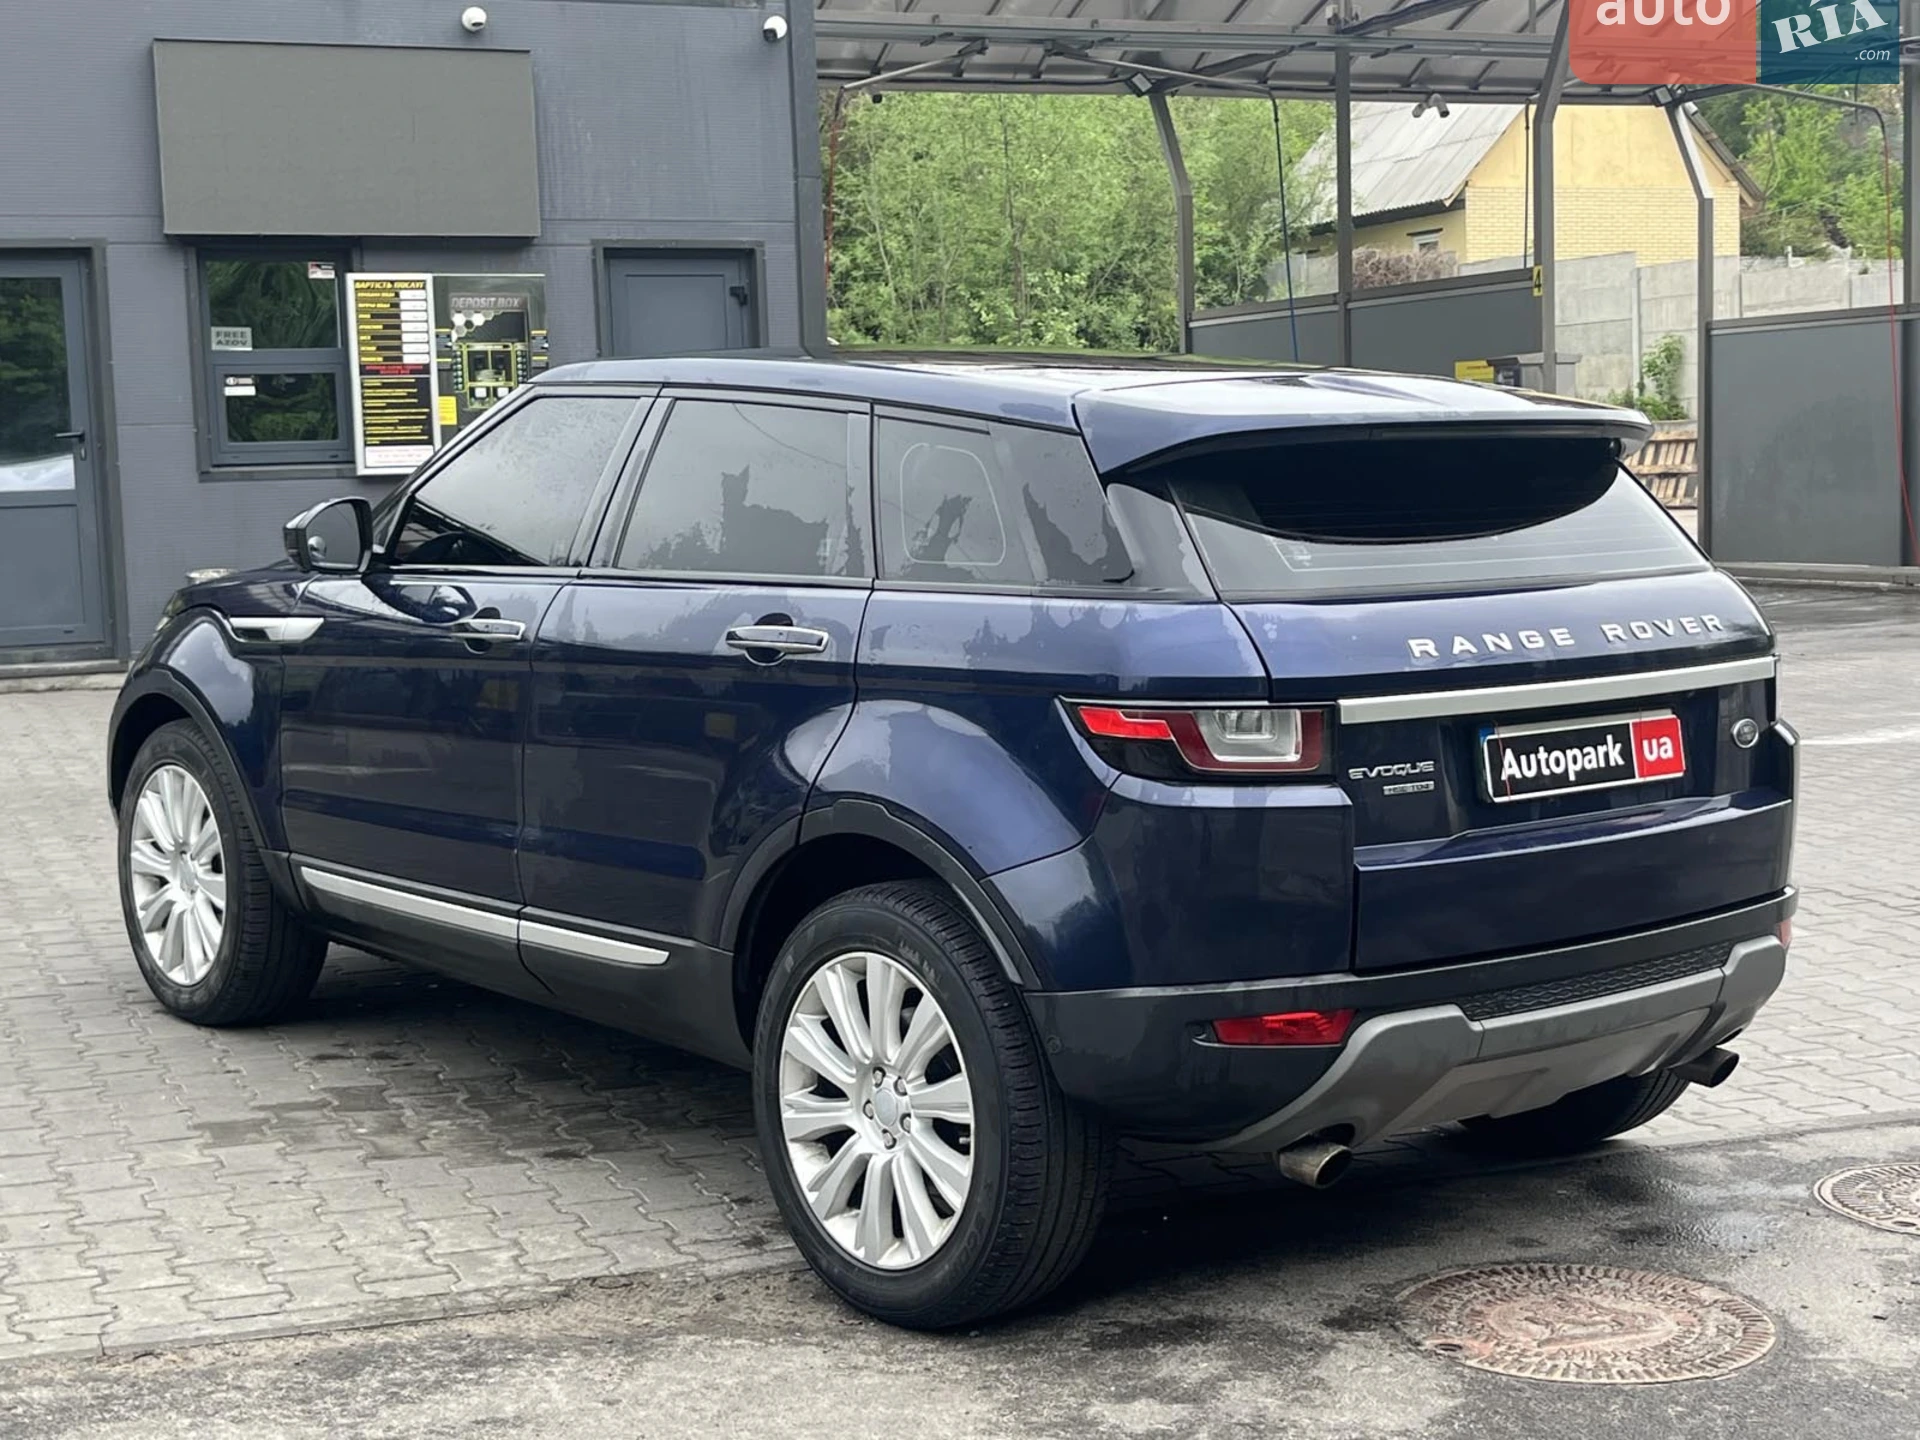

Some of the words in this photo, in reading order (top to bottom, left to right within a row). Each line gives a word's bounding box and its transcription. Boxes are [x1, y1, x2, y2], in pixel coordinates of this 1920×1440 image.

[1534, 268, 1542, 293] 4
[451, 297, 496, 308] DEPOSIT
[497, 297, 520, 308] BOX
[215, 330, 247, 338] FREE
[1407, 627, 1575, 659] RANGE
[1600, 613, 1724, 643] ROVER
[1501, 734, 1625, 781] Autopark
[1642, 736, 1674, 762] ua
[1348, 760, 1435, 780] EVOQUE
